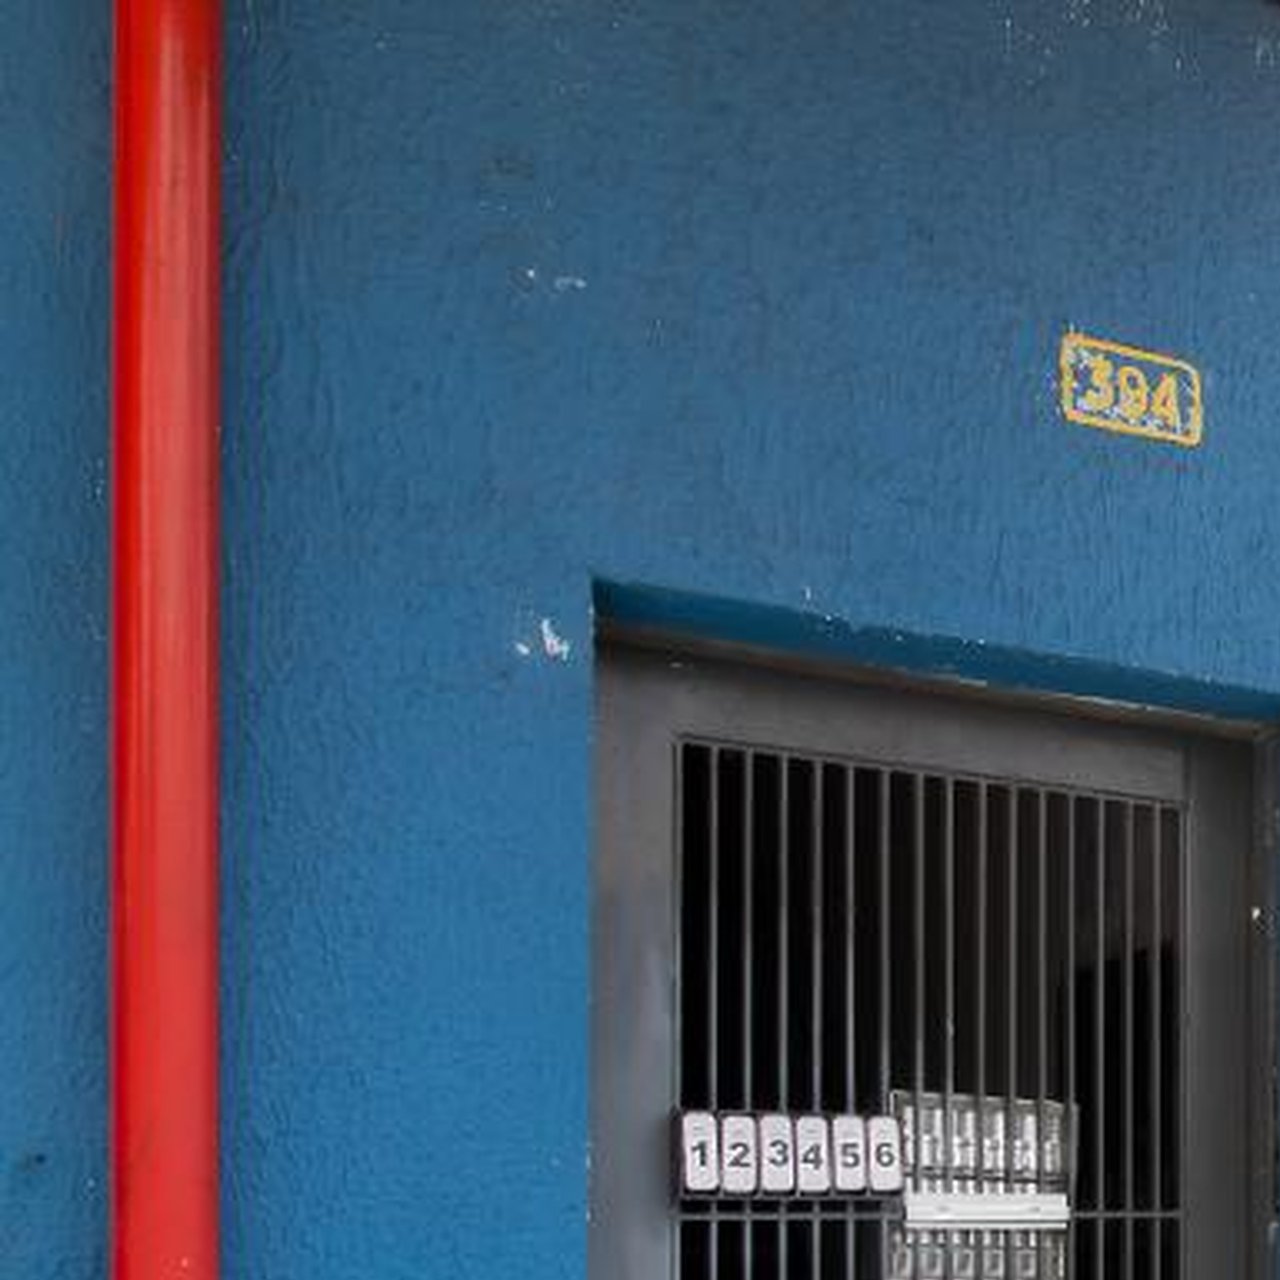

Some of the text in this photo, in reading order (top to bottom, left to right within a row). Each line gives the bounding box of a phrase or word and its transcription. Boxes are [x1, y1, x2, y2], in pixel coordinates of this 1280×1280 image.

[691, 1139, 896, 1170] 1 2 3 4 5 6
